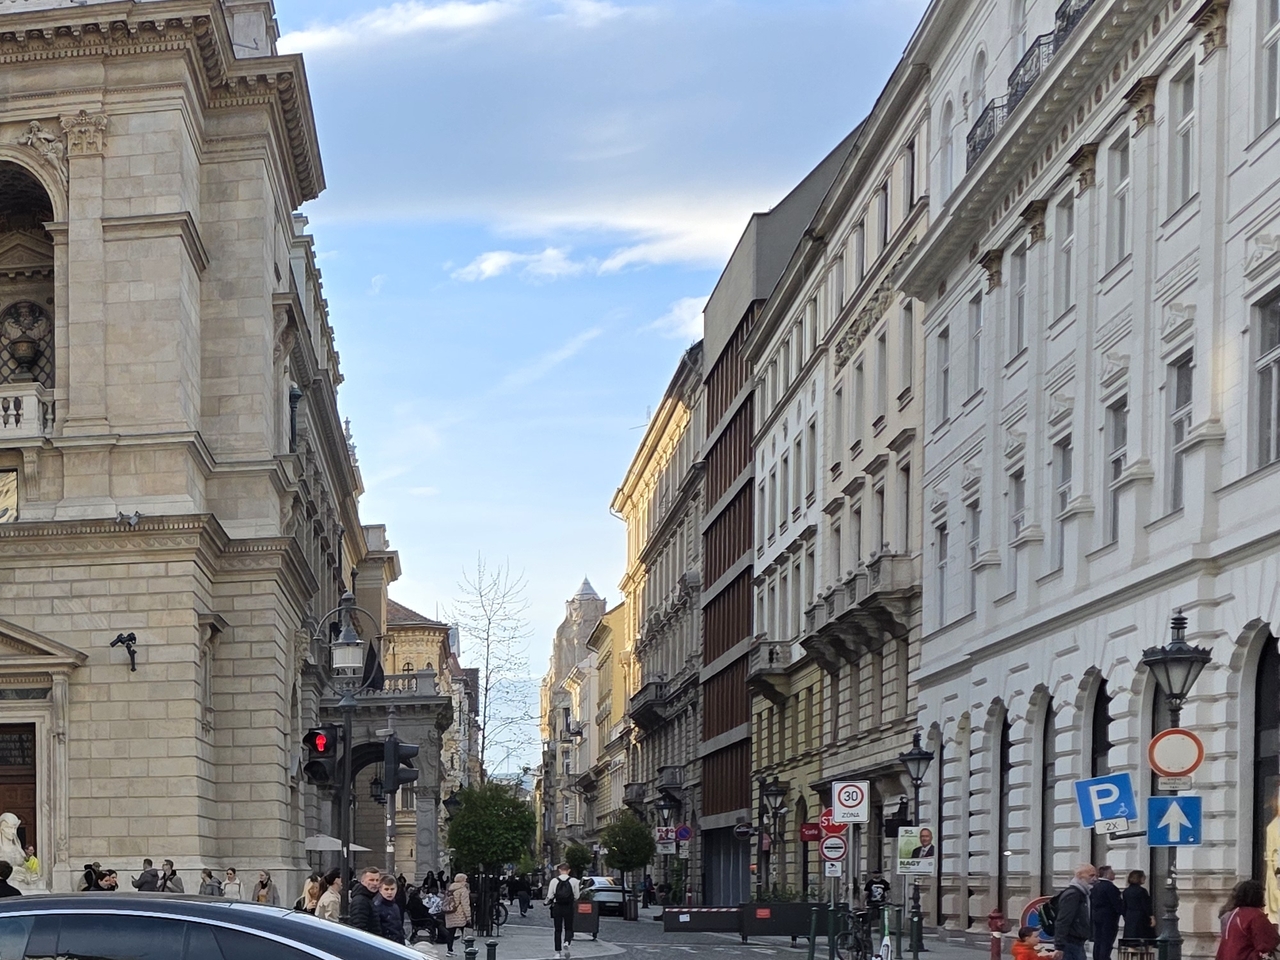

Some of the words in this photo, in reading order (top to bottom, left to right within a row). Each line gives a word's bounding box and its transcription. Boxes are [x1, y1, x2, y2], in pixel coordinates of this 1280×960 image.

[843, 790, 859, 802] 30
[1089, 783, 1120, 820] P
[841, 811, 860, 819] ZÓNA
